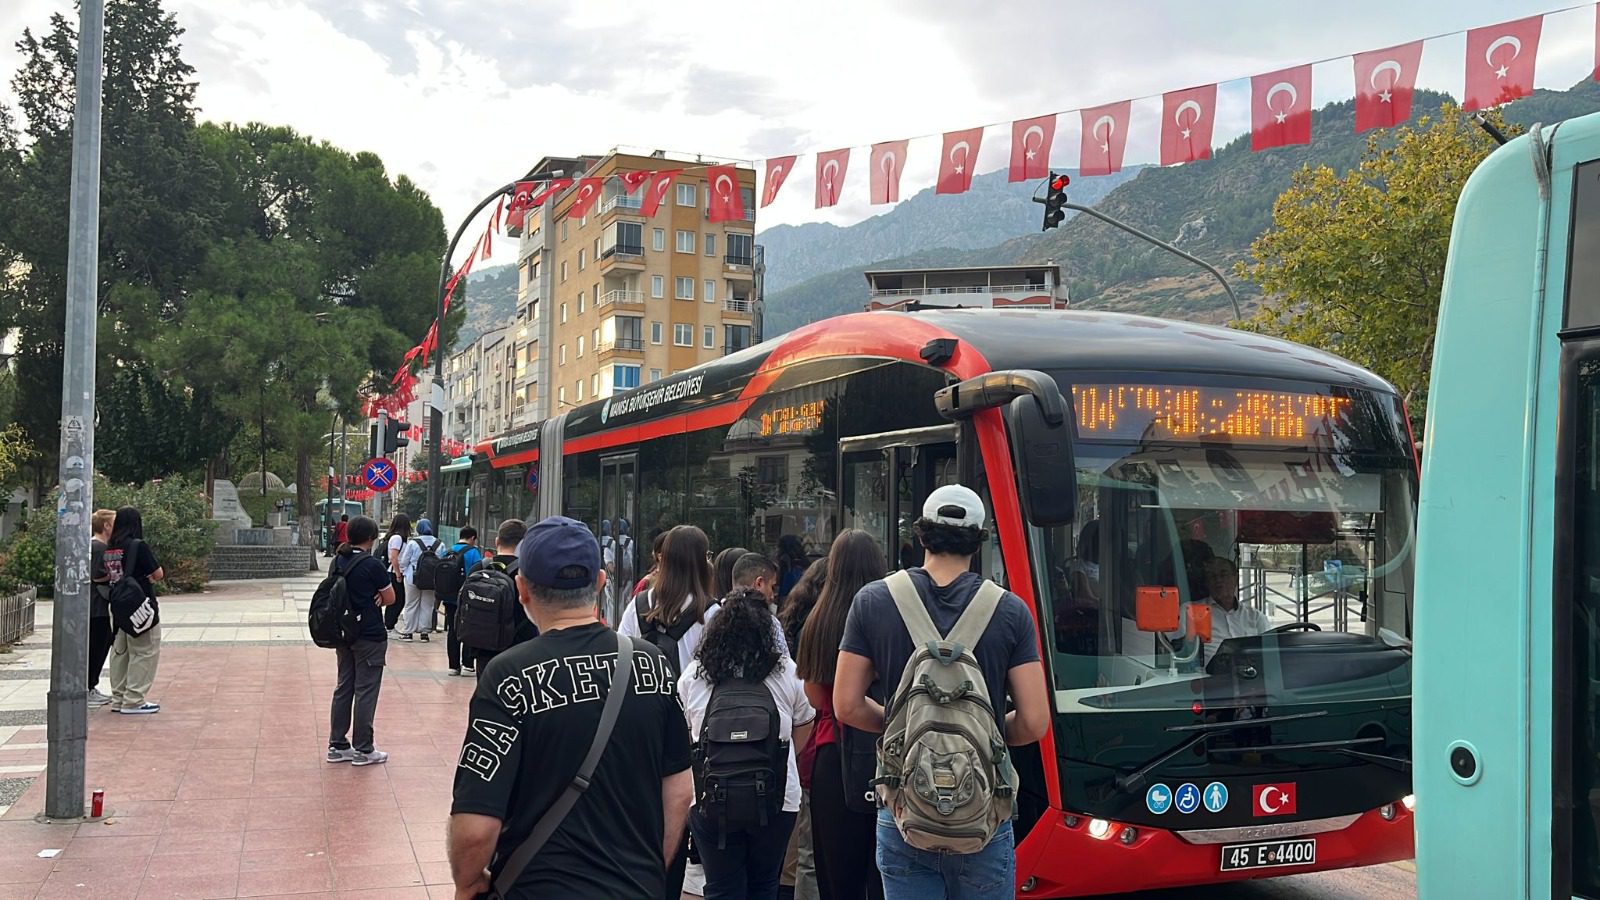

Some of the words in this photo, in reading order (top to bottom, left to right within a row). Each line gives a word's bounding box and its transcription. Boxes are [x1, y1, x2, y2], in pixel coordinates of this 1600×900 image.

[664, 370, 706, 403] BELEDİYESİ
[458, 650, 685, 782] BASKETBA
[1230, 848, 1249, 868] 45
[1257, 846, 1268, 865] E
[1276, 842, 1313, 863] 4400
